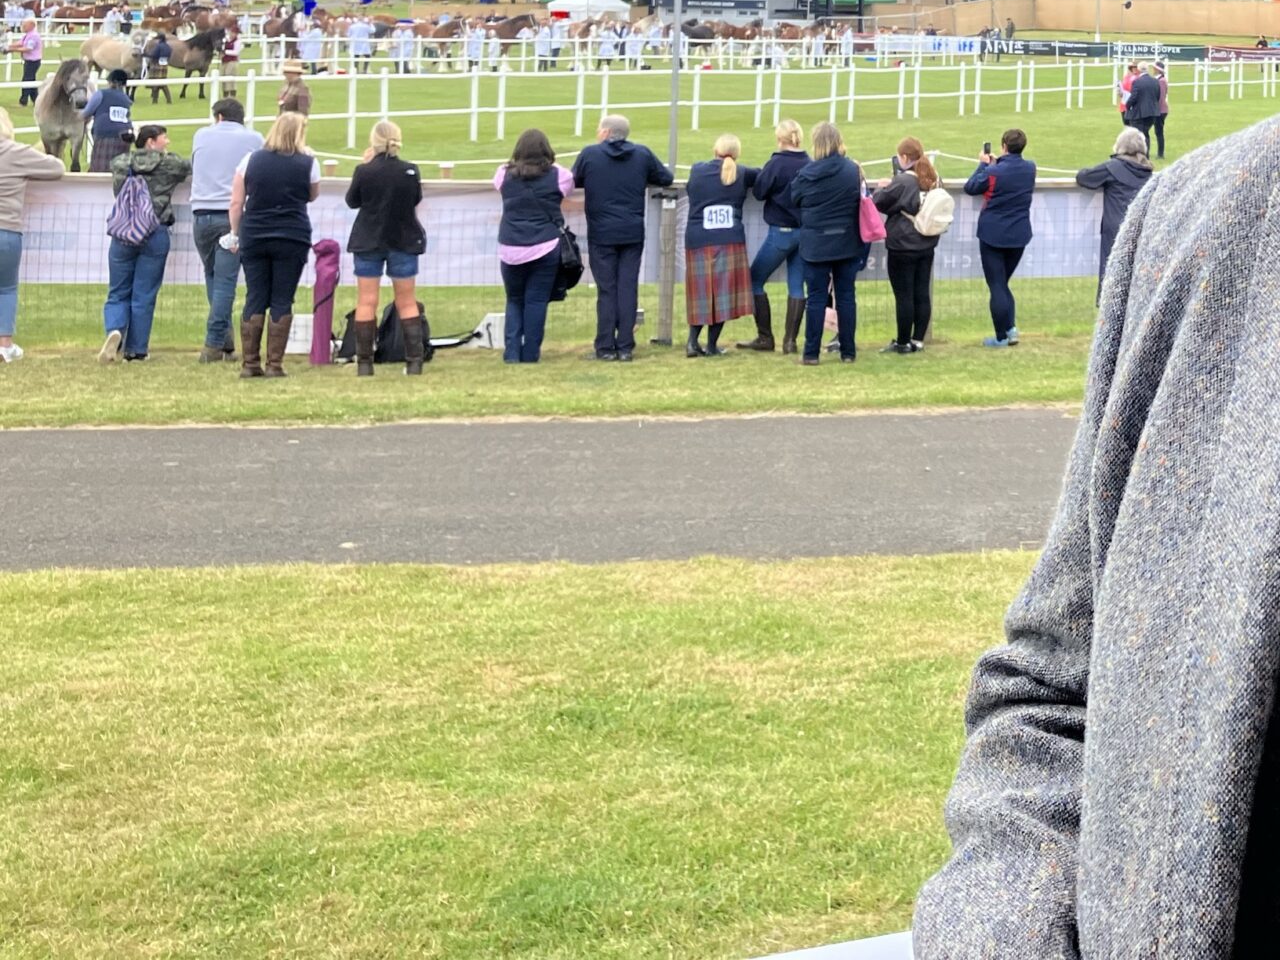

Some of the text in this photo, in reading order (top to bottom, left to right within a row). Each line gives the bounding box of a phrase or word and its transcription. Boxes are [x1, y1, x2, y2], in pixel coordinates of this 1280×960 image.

[1113, 45, 1181, 54] HOLLAND COOPER
[707, 208, 731, 224] 4151
